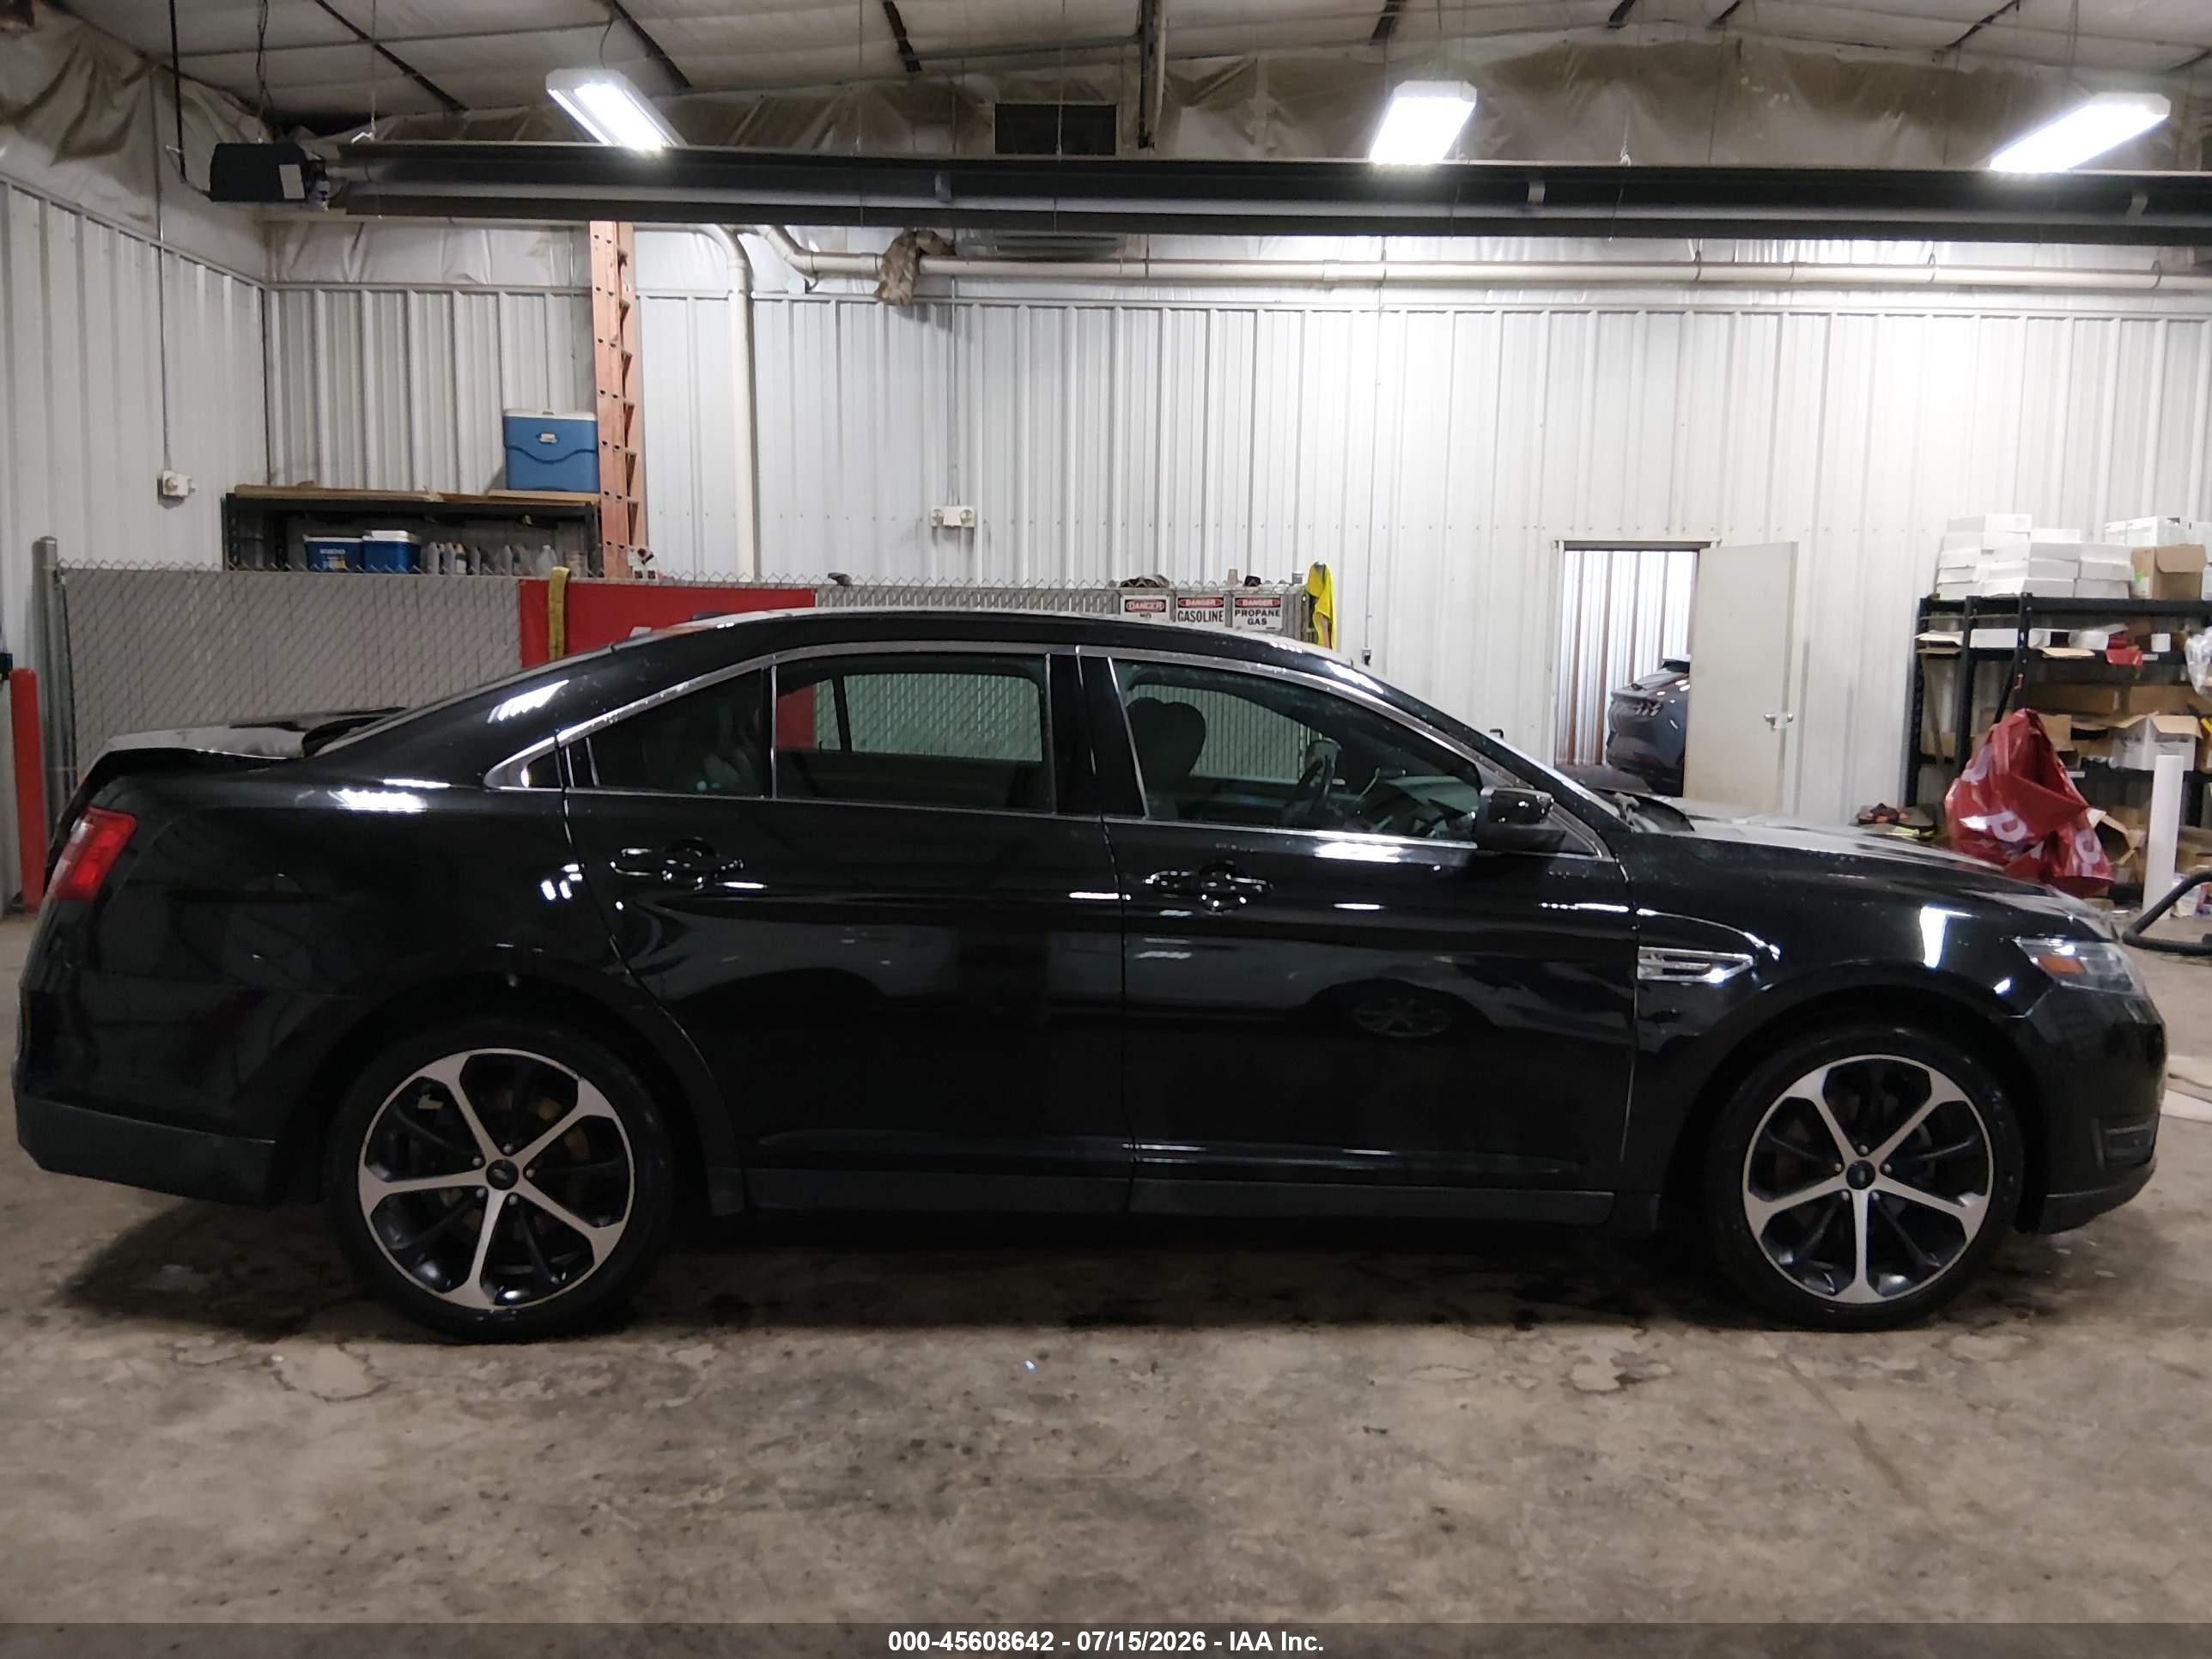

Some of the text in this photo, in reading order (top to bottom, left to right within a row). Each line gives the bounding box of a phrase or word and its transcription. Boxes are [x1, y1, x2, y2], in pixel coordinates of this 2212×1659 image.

[1127, 601, 1163, 611] DANGER
[1185, 598, 1216, 606] DANGER
[1242, 598, 1273, 606] DANGER
[1177, 610, 1224, 623] GASOLINE
[1234, 609, 1280, 617] PROPANE
